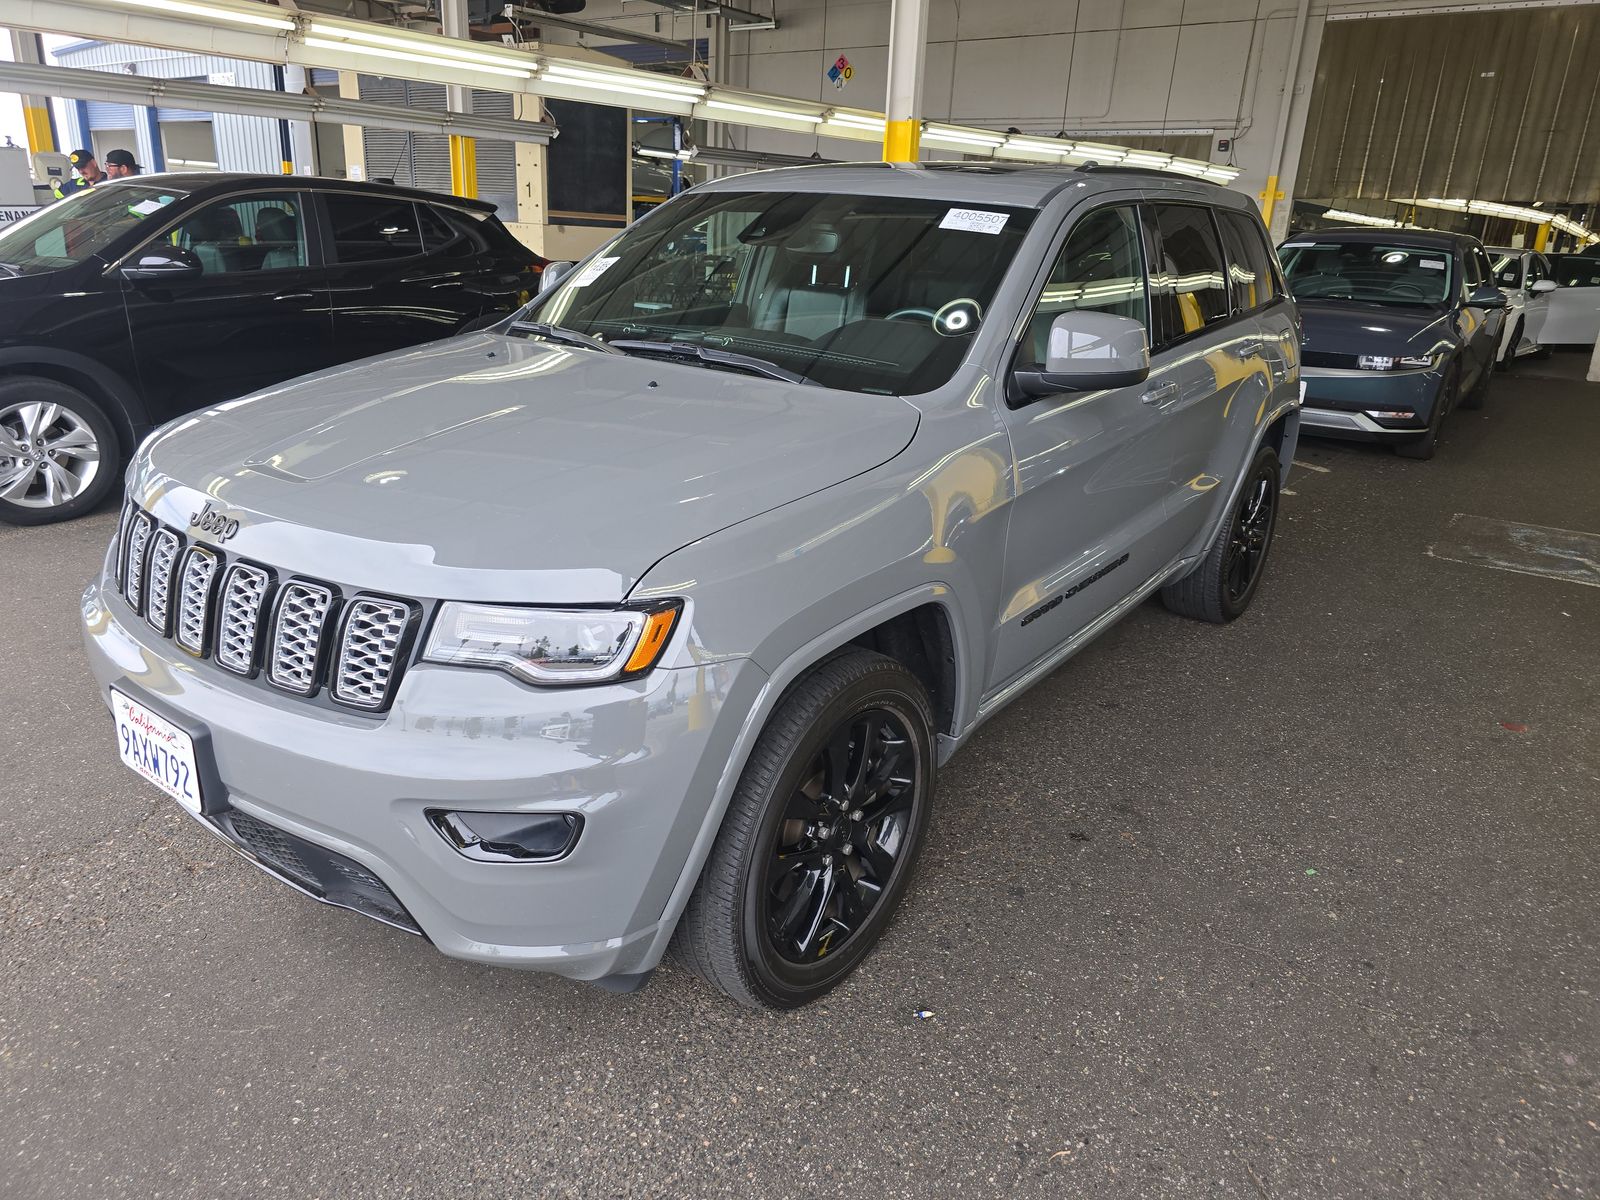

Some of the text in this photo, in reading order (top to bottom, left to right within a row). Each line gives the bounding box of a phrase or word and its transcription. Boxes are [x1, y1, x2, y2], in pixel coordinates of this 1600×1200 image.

[838, 57, 845, 70] 3
[844, 66, 852, 79] 0
[525, 181, 531, 198] 1
[952, 211, 1008, 224] 4005507
[190, 502, 240, 544] Jeep
[128, 706, 174, 742] California
[121, 723, 193, 799] 9AXW792
